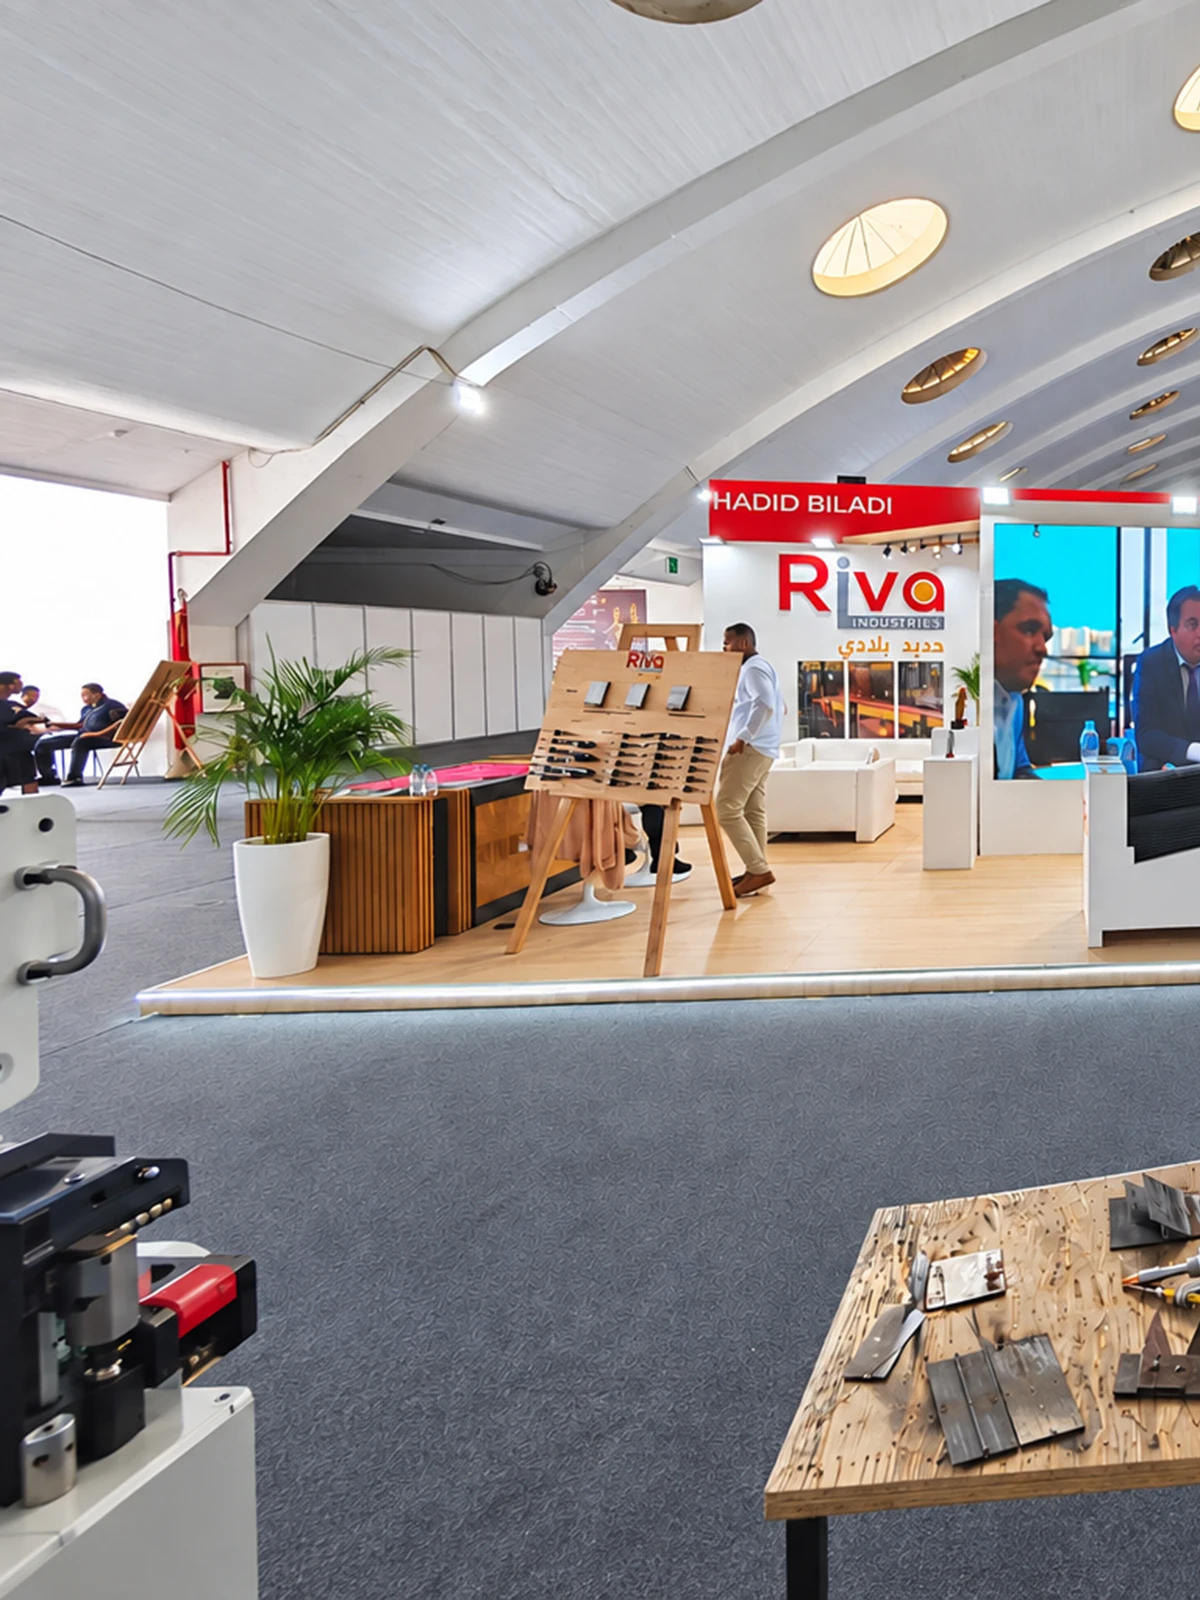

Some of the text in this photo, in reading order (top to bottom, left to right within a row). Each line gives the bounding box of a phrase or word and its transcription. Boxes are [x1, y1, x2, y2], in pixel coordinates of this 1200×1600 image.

[713, 491, 893, 515] HADID BILADI
[778, 553, 945, 613] Riva
[852, 616, 941, 629] INDUSTRIES
[838, 635, 944, 660] حديد بلادي
